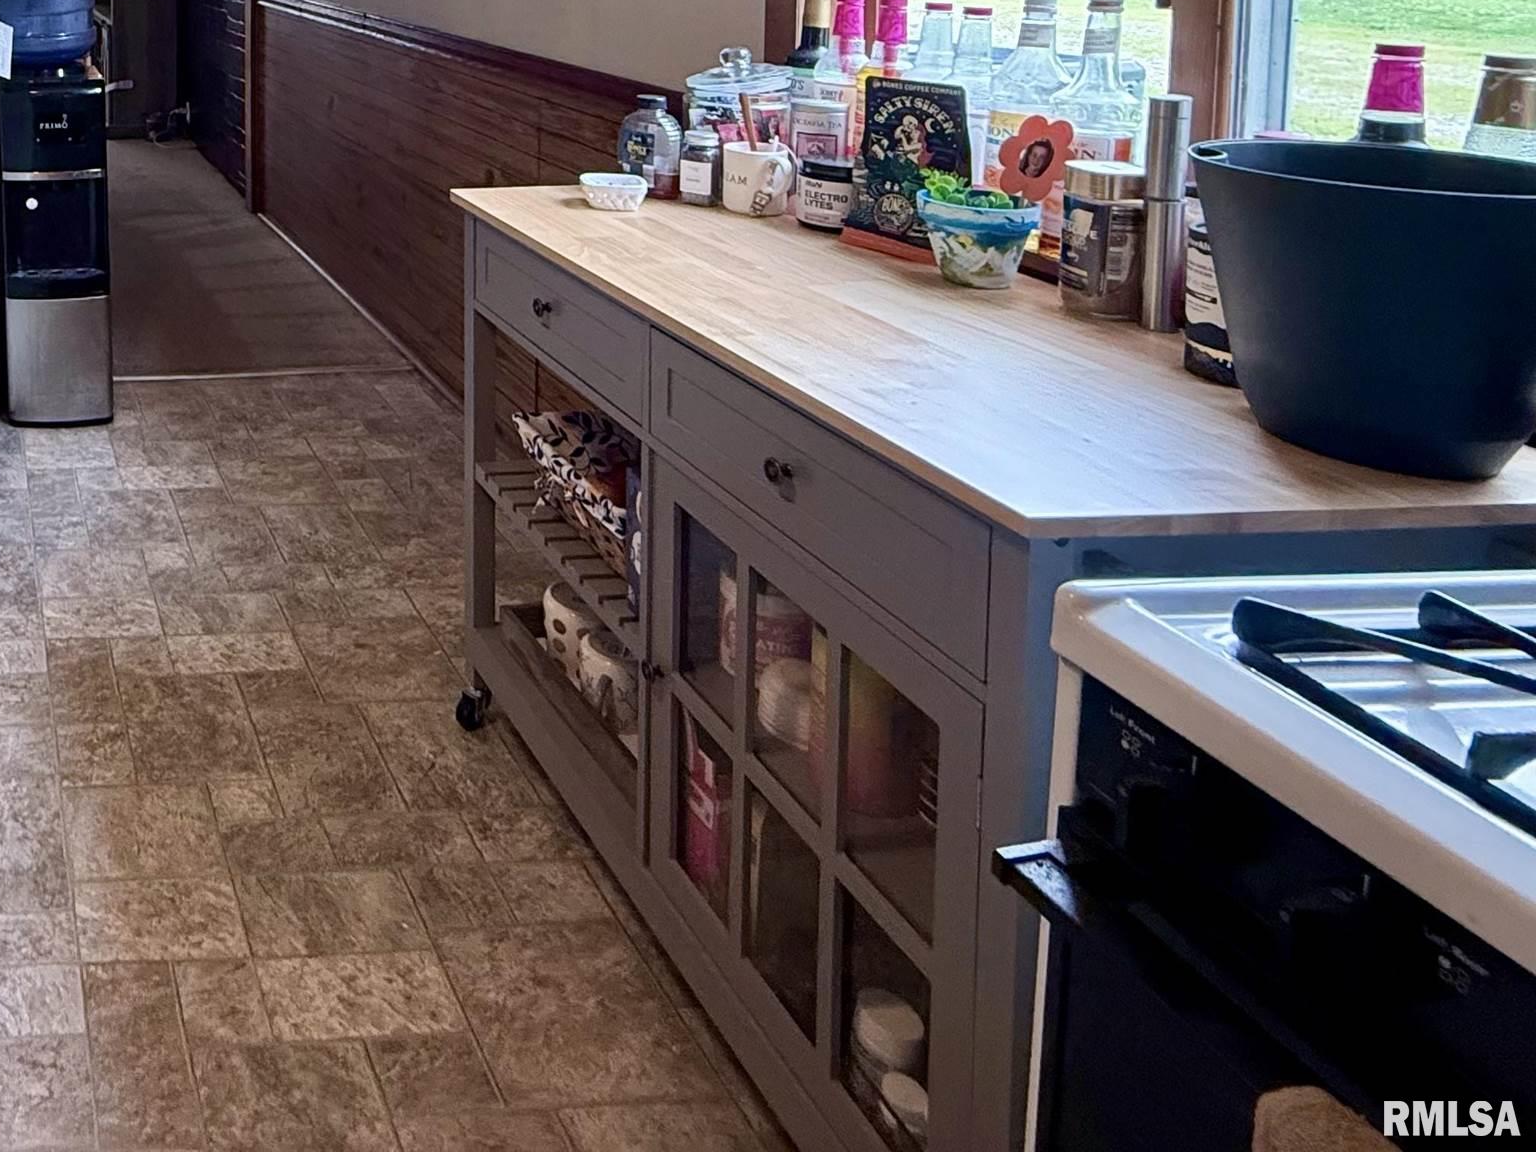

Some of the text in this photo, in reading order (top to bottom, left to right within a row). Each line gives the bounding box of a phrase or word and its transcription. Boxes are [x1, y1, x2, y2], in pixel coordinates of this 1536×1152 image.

[874, 96, 955, 134] SALTY SIREN
[804, 198, 834, 210] LYTES
[805, 189, 849, 204] ELECTRO
